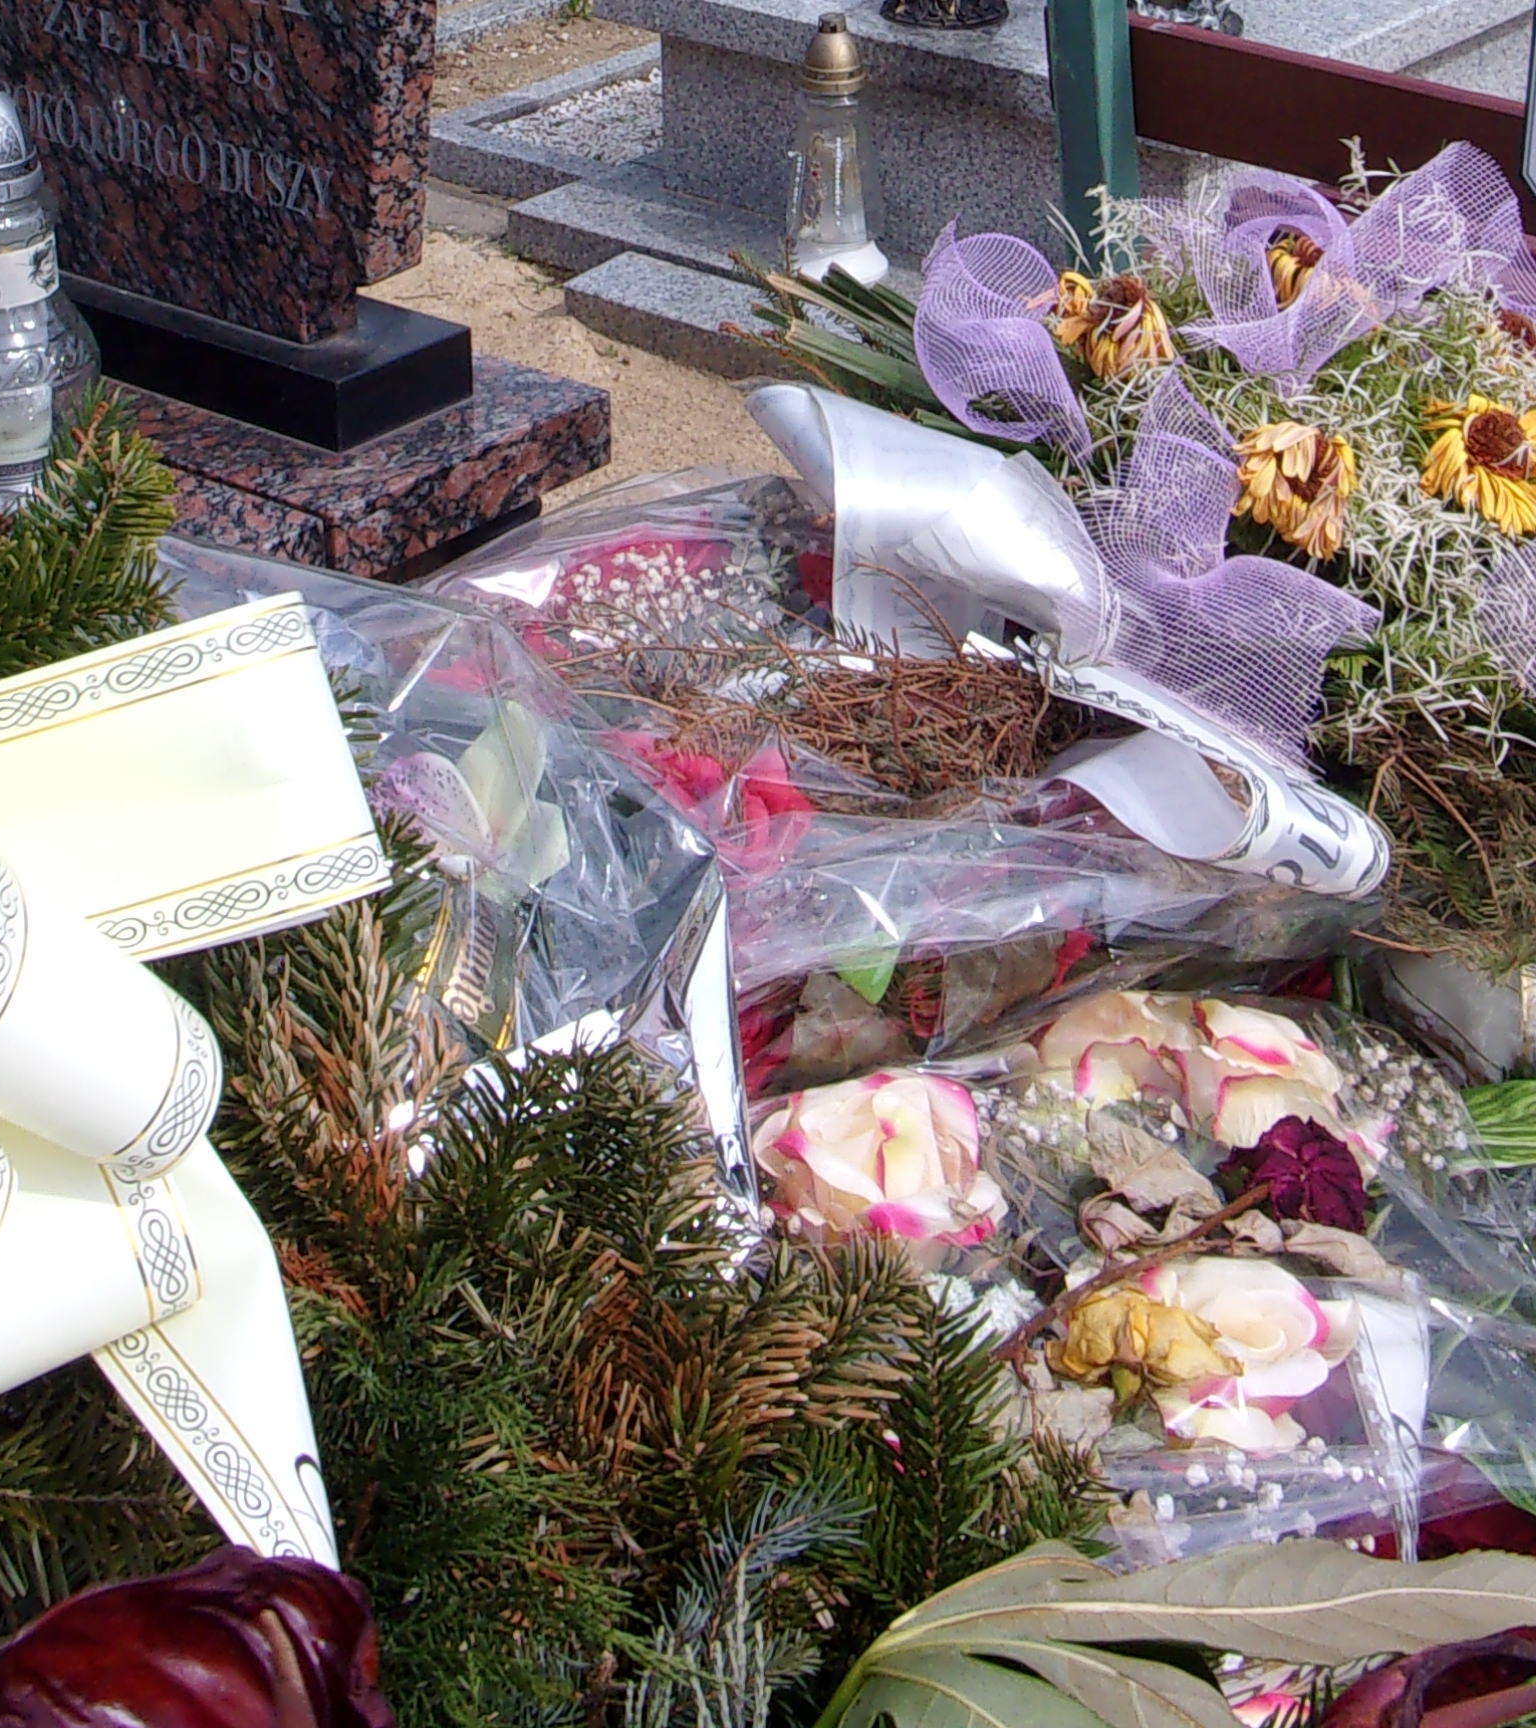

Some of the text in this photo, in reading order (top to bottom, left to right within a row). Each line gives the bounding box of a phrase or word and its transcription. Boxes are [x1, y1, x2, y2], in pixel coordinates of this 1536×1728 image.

[136, 19, 215, 74] LAT
[228, 41, 278, 94] 58
[107, 114, 208, 186] JEGO
[215, 137, 335, 217] DUSZY
